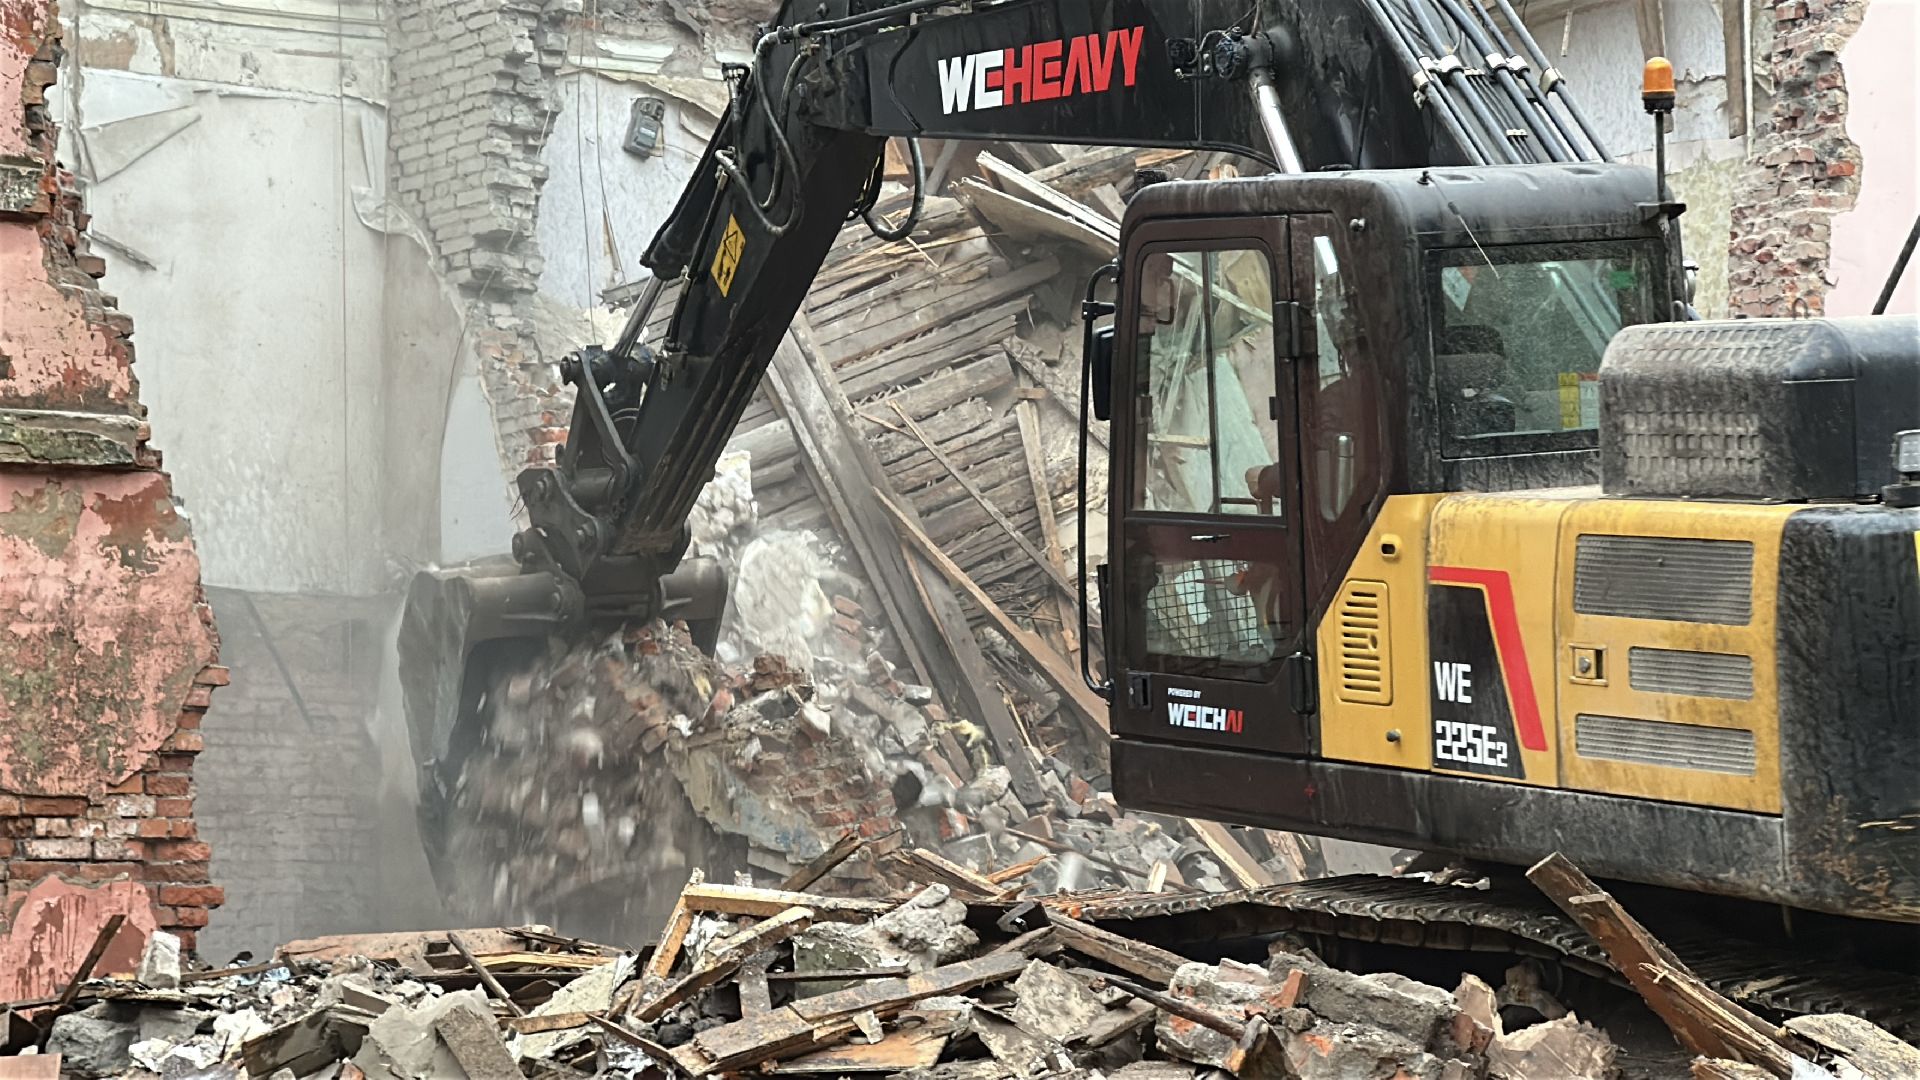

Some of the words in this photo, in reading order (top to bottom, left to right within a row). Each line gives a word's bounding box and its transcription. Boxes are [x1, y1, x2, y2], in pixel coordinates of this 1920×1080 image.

[938, 26, 1144, 115] WEHEAVY
[1434, 661, 1472, 704] WE
[1167, 702, 1243, 734] WEICHAI
[1435, 719, 1508, 768] 225E2
